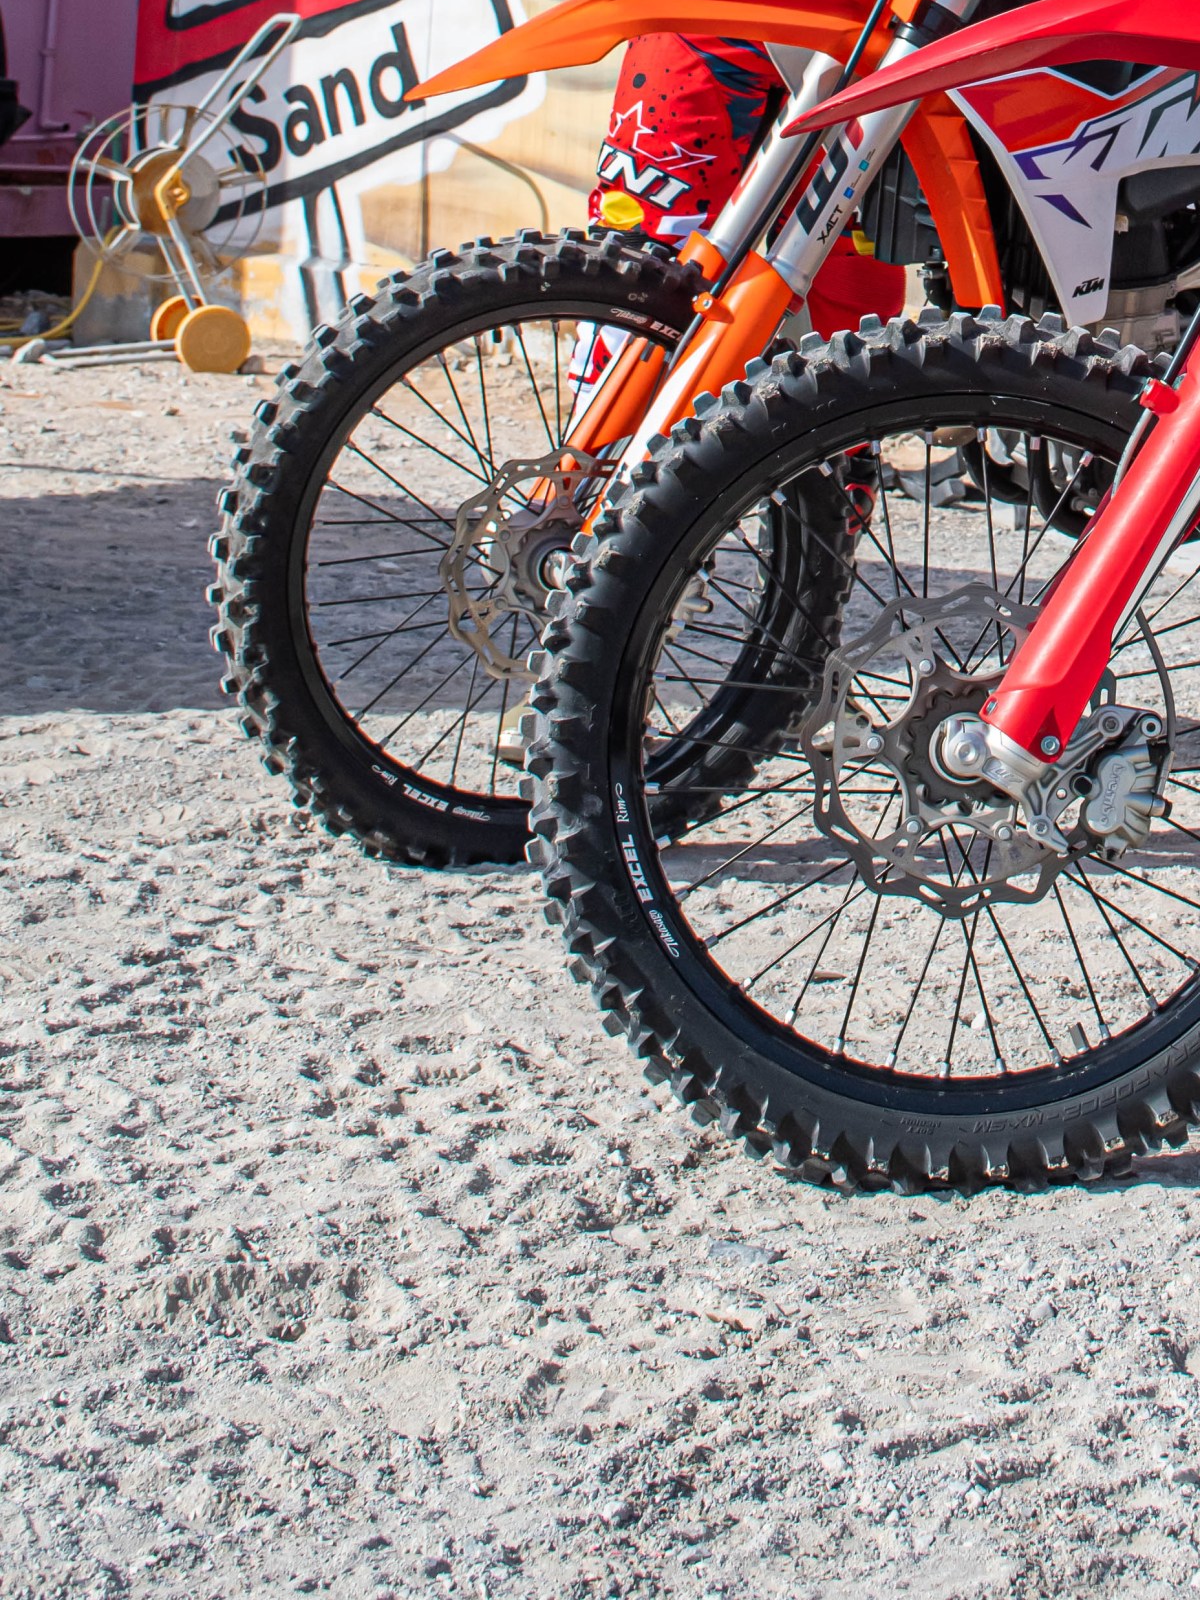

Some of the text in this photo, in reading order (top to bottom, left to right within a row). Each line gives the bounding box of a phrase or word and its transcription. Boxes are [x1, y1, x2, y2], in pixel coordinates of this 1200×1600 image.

[228, 23, 427, 172] Sand
[816, 204, 844, 245] XACT
[1071, 276, 1105, 299] KTM
[402, 783, 450, 813] EXCEL
[615, 782, 630, 823] Rim
[621, 833, 655, 904] EXCEL
[648, 909, 680, 958] Takasago
